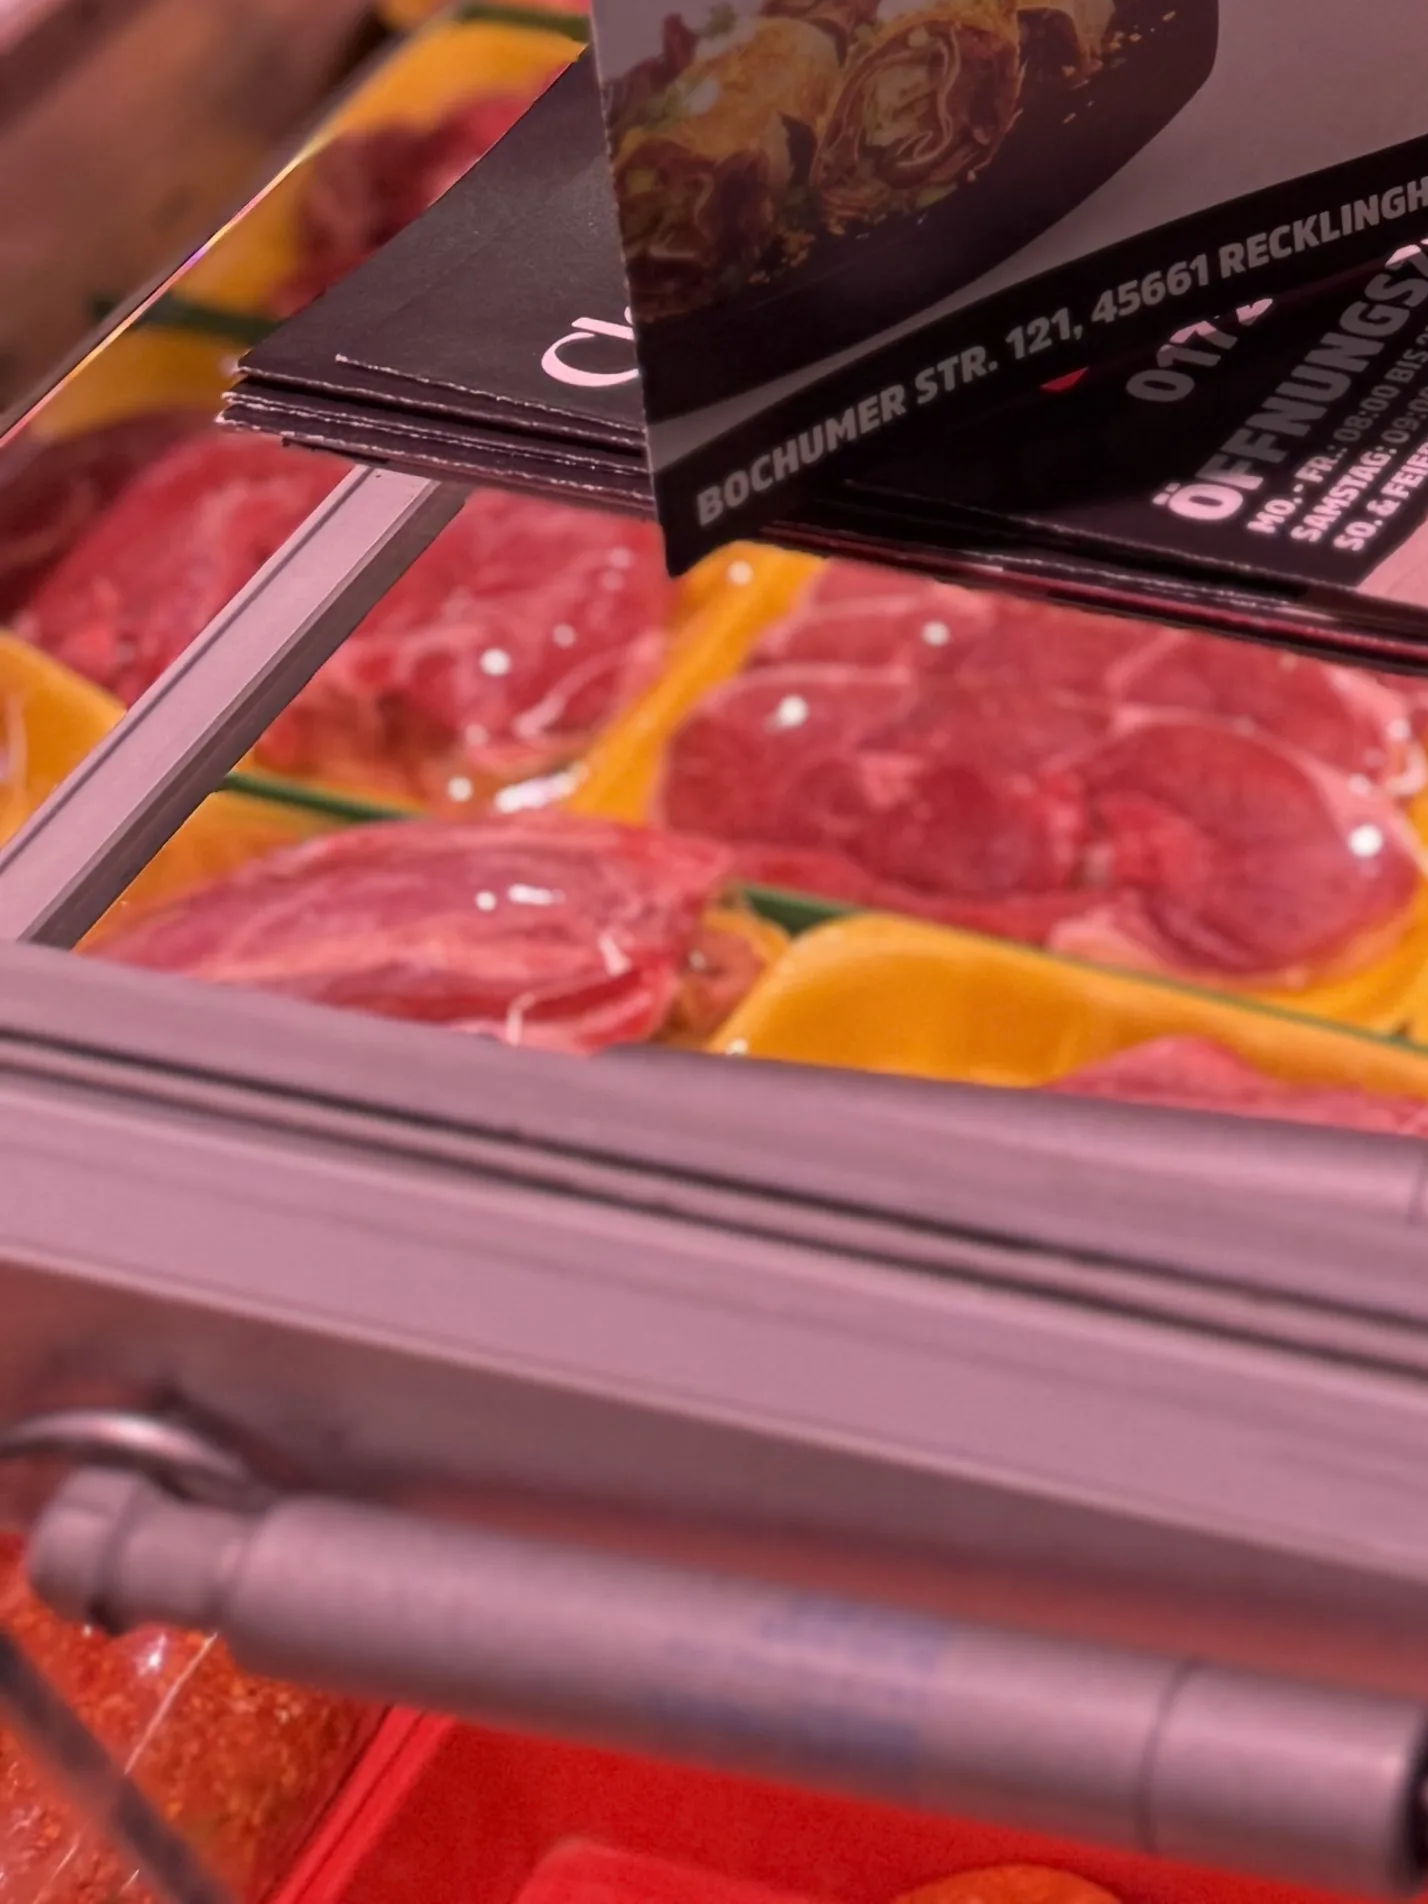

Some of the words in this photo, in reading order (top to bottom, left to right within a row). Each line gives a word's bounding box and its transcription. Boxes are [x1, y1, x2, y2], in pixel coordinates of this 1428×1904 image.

[696, 384, 908, 527] BOCHUMER
[916, 344, 998, 407] STR.
[1005, 307, 1084, 360] 121,
[1090, 255, 1210, 326] 45661
[1247, 496, 1304, 534] MO.
[1333, 384, 1399, 443] 08:00
[1290, 444, 1398, 544] SAMSTAG:
[1333, 518, 1384, 552] SO.
[1366, 490, 1401, 517] &
